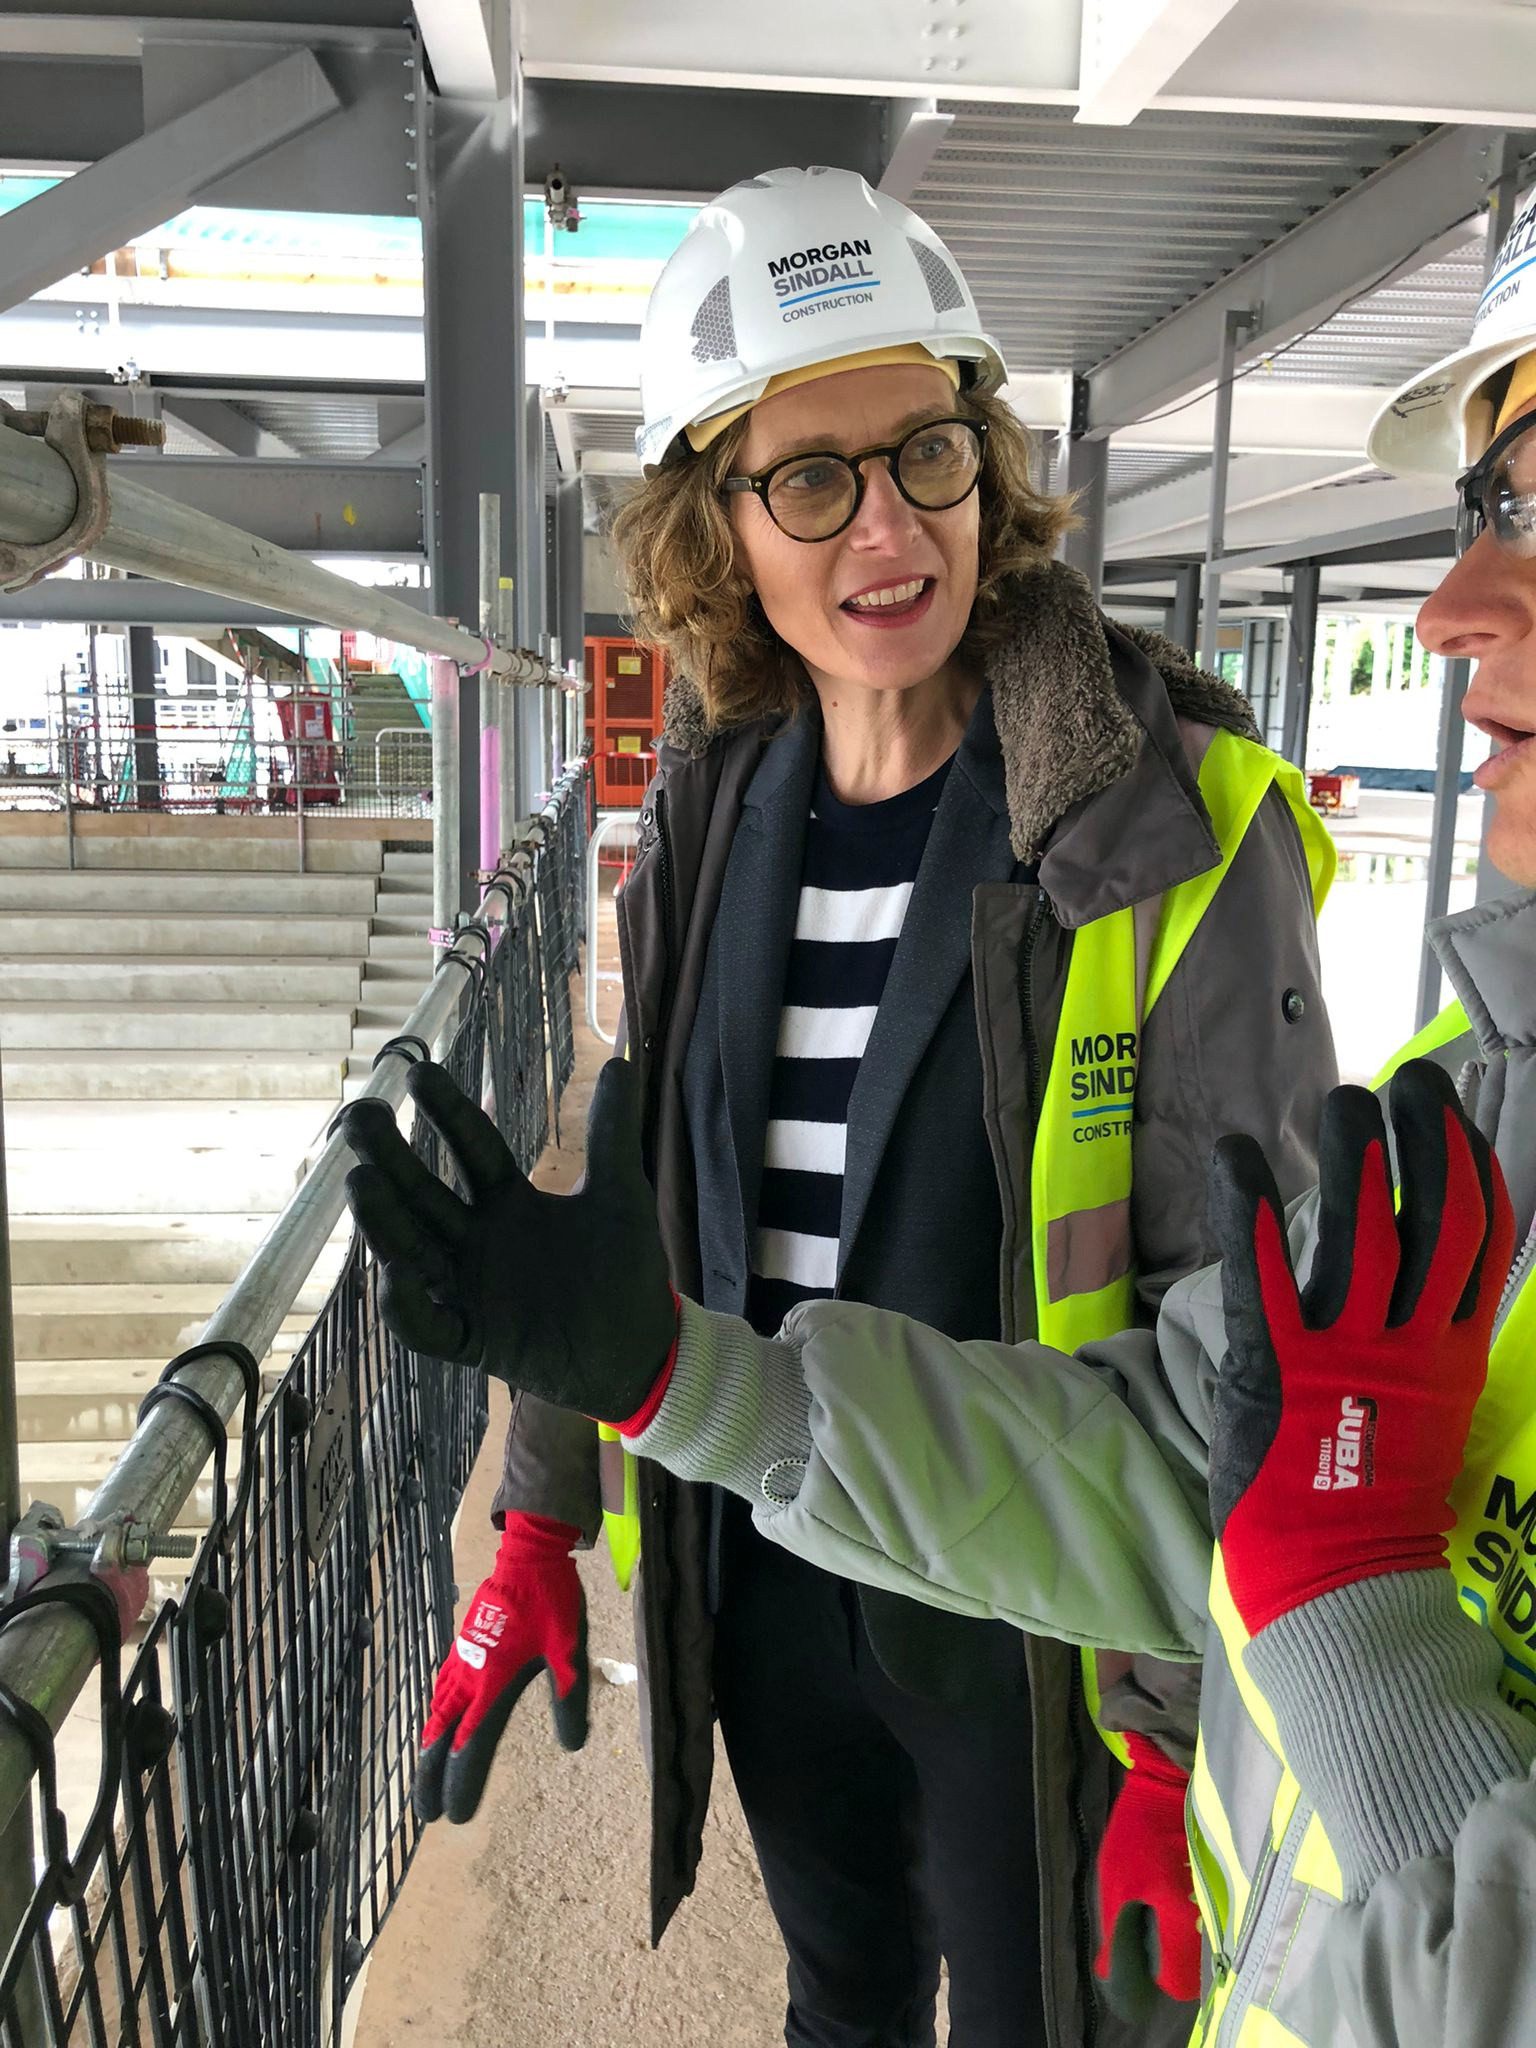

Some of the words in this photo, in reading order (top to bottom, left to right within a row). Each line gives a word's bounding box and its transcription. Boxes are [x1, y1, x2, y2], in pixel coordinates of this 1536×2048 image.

[767, 239, 872, 278] MORGAN
[773, 260, 873, 297] SINDALL
[782, 292, 873, 323] CONSTRUCTION
[1070, 1032, 1136, 1067] MOR
[1070, 1066, 1135, 1101] SIND
[1073, 1120, 1133, 1143] CONSTR
[1333, 1396, 1364, 1490] JUBA
